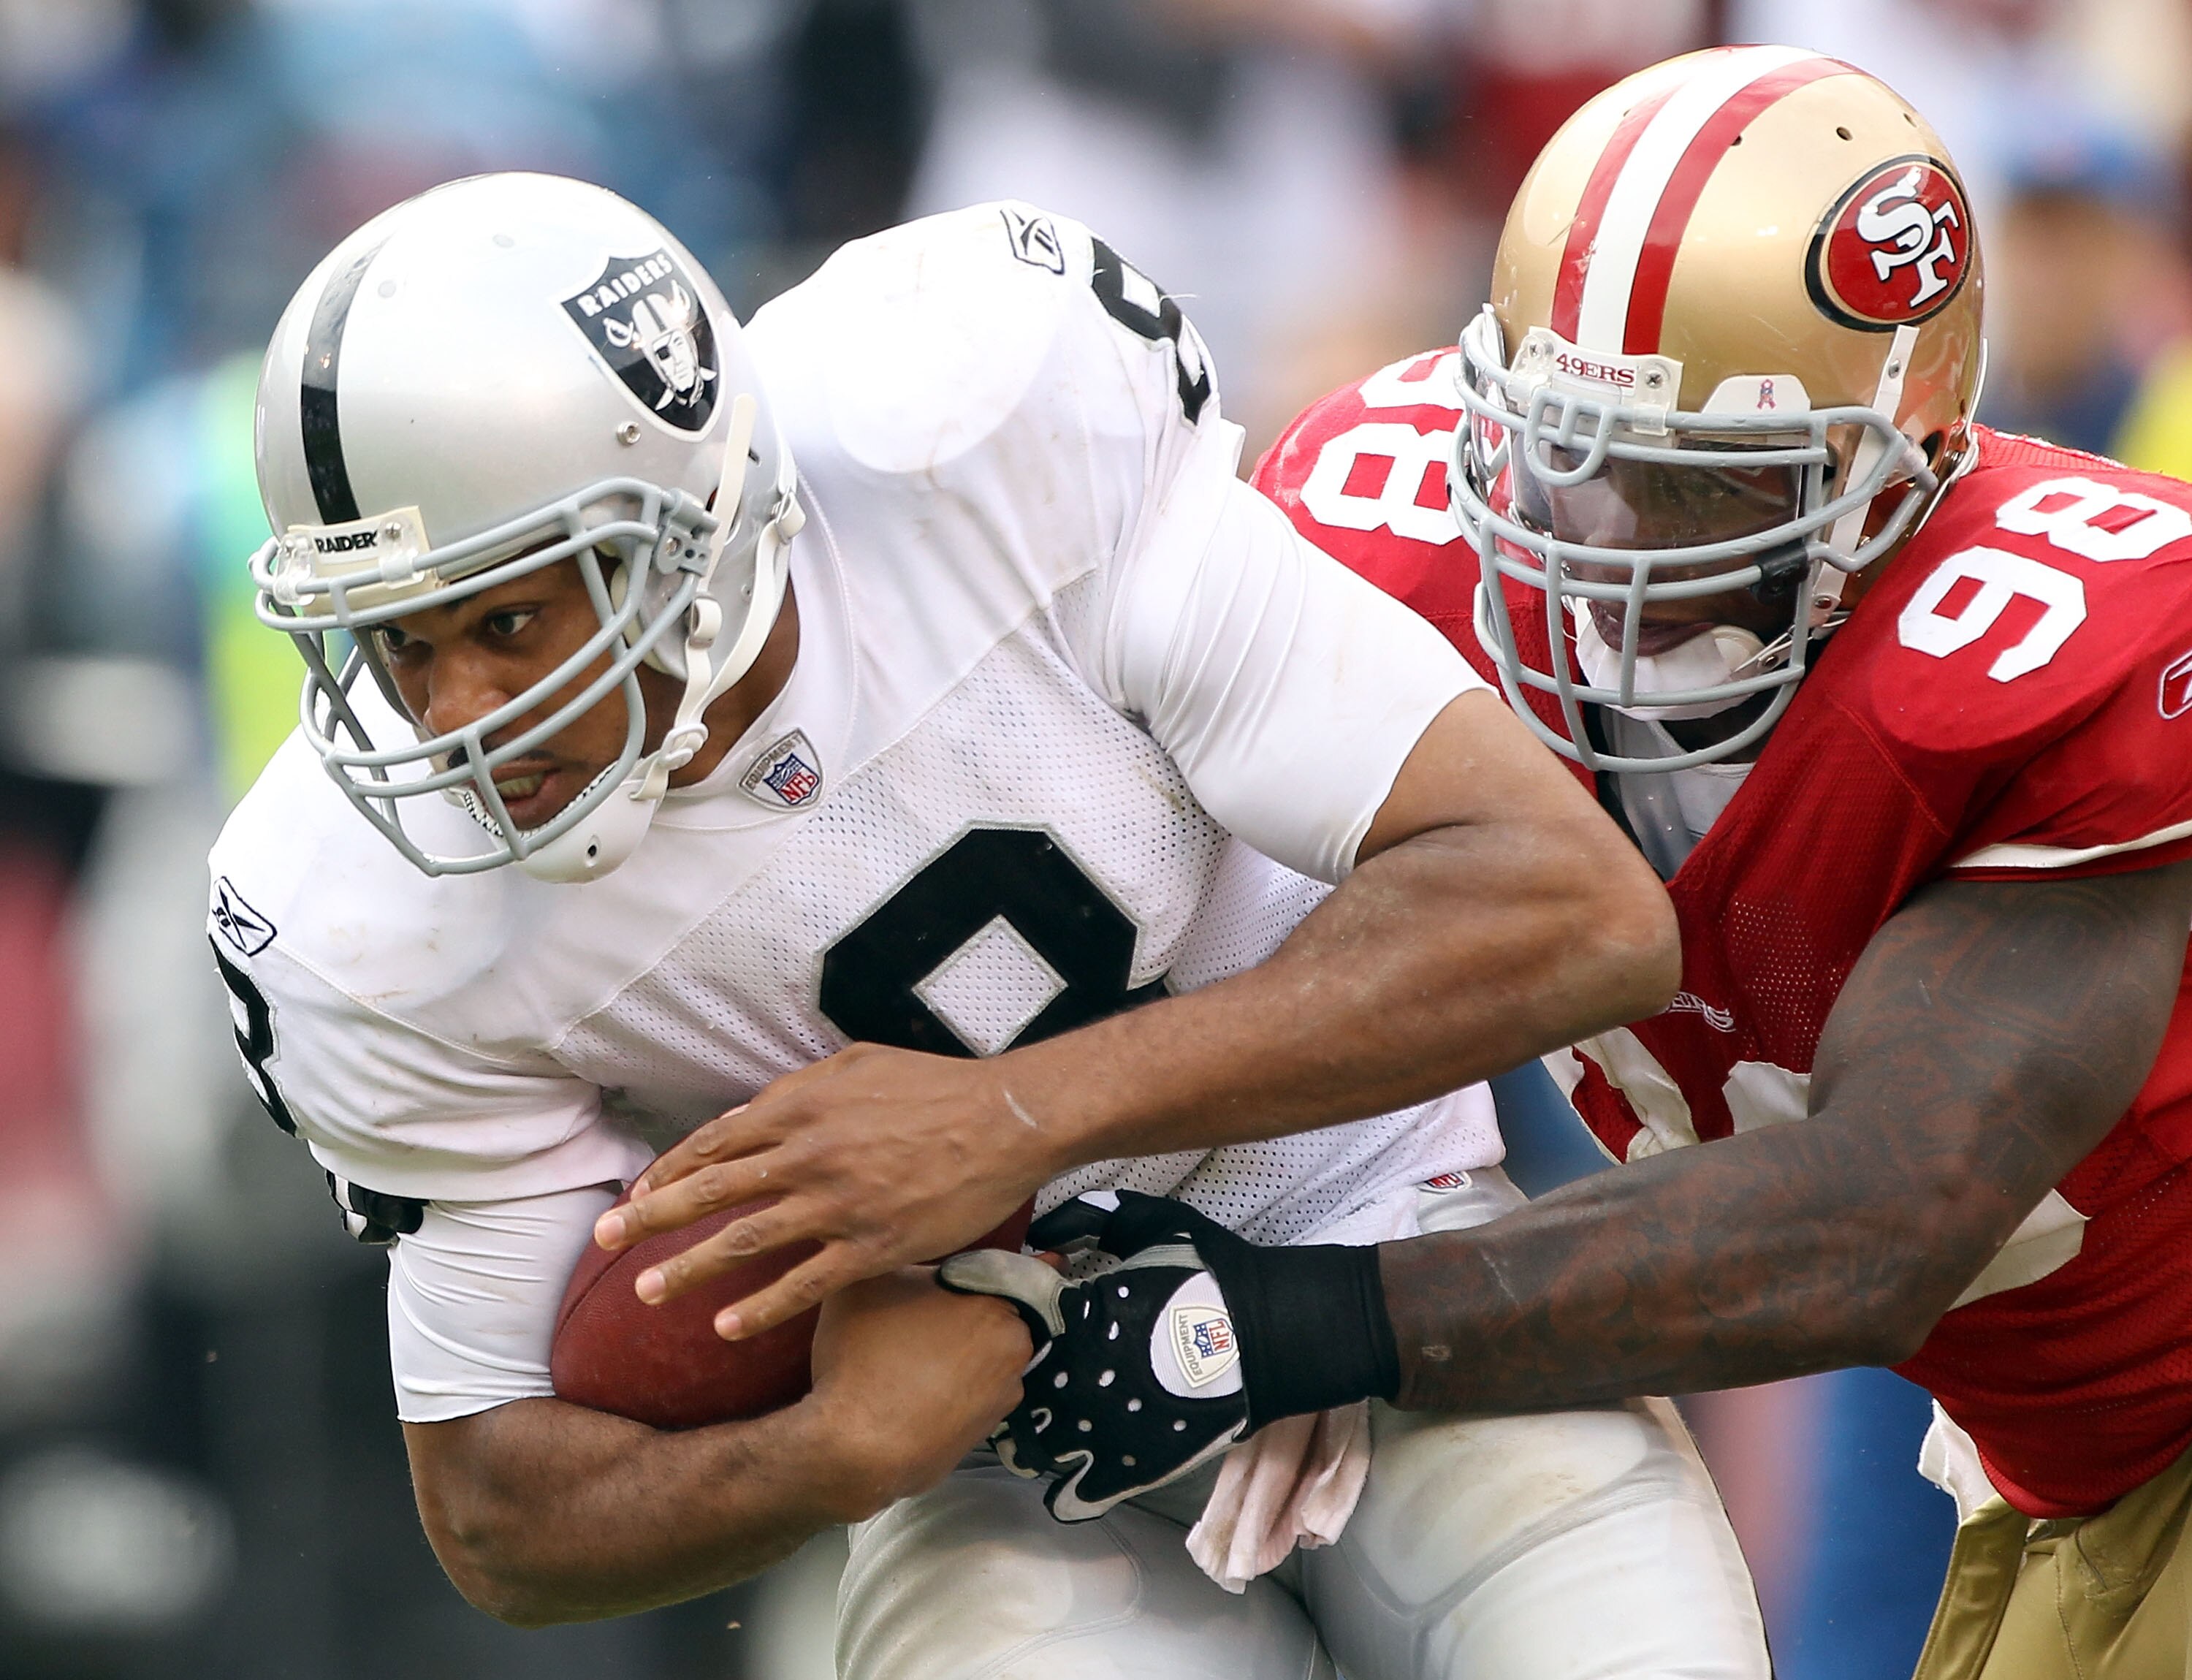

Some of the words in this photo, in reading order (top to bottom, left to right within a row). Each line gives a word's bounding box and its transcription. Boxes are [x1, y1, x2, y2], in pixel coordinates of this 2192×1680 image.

[1857, 165, 1959, 308] SF
[577, 254, 673, 317] RAIDERS
[1556, 353, 1635, 384] 49ERS
[314, 530, 378, 553] RAIDER
[1898, 476, 2192, 683] 98
[745, 734, 802, 791] EQUIPMENT
[780, 772, 816, 802] NFL
[1179, 1314, 1203, 1376] EQUIPMENT
[1209, 1320, 1230, 1352] NFL
